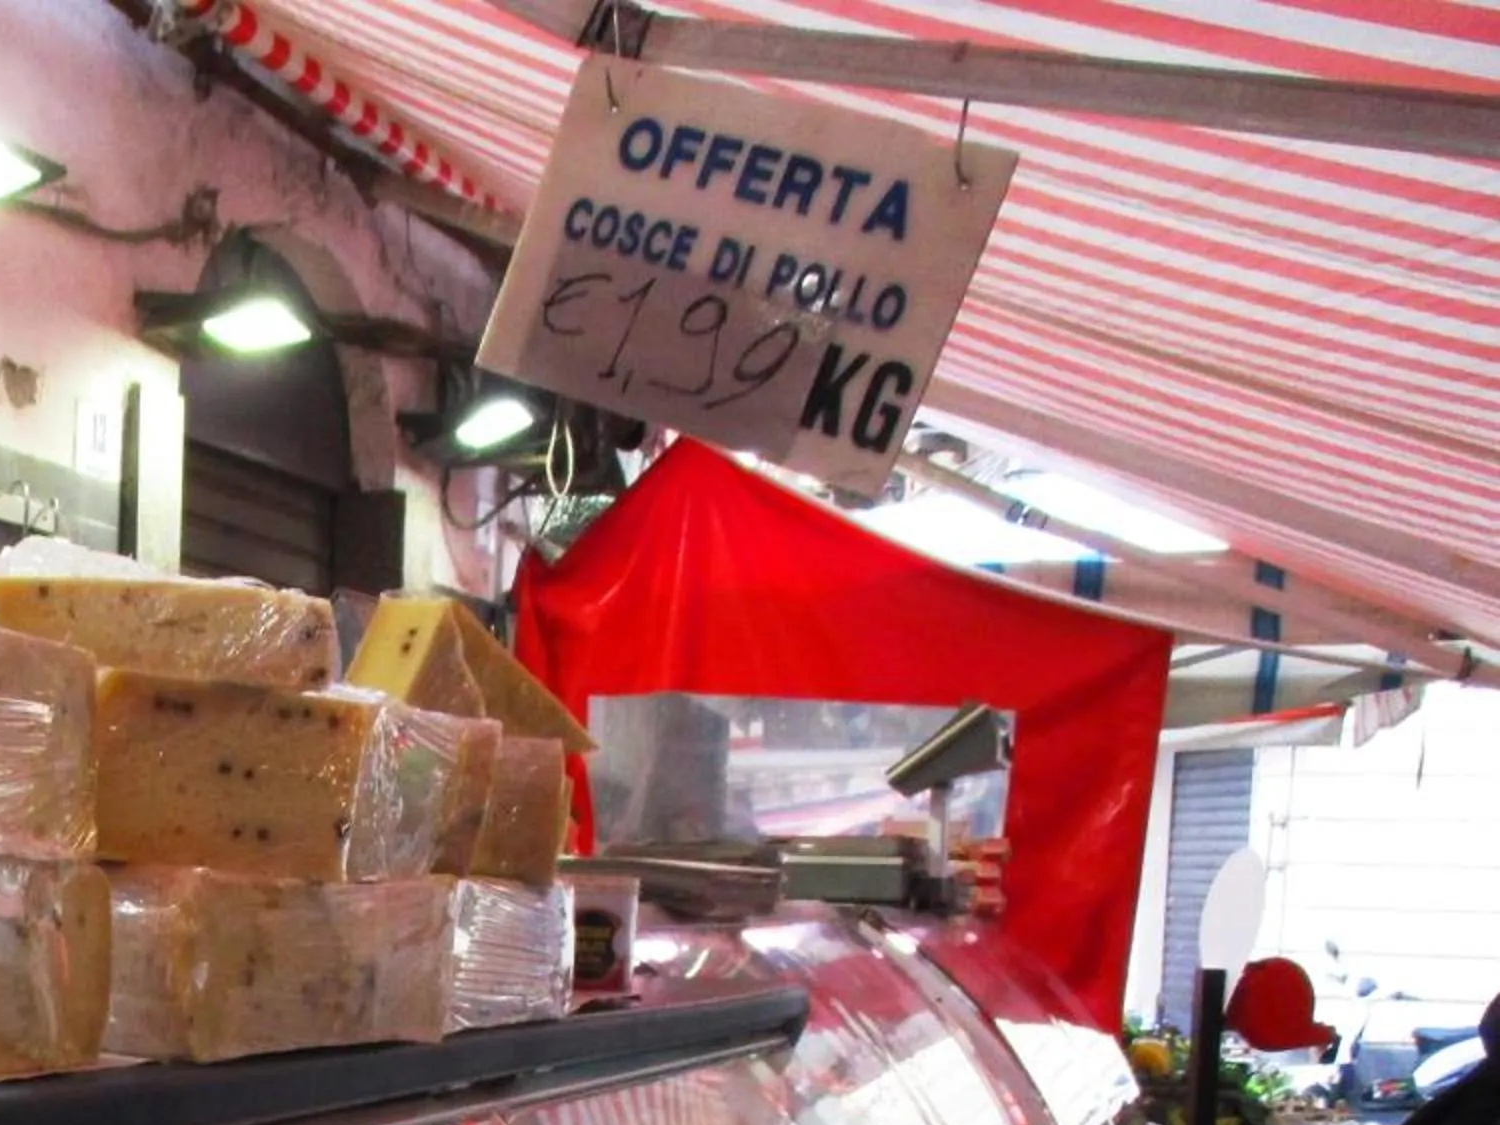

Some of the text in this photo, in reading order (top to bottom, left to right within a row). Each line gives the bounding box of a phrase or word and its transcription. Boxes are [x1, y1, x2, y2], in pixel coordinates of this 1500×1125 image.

[618, 117, 913, 242] OFFERTA
[564, 197, 907, 330] COSCE DI POLLO
[800, 343, 915, 455] KG
